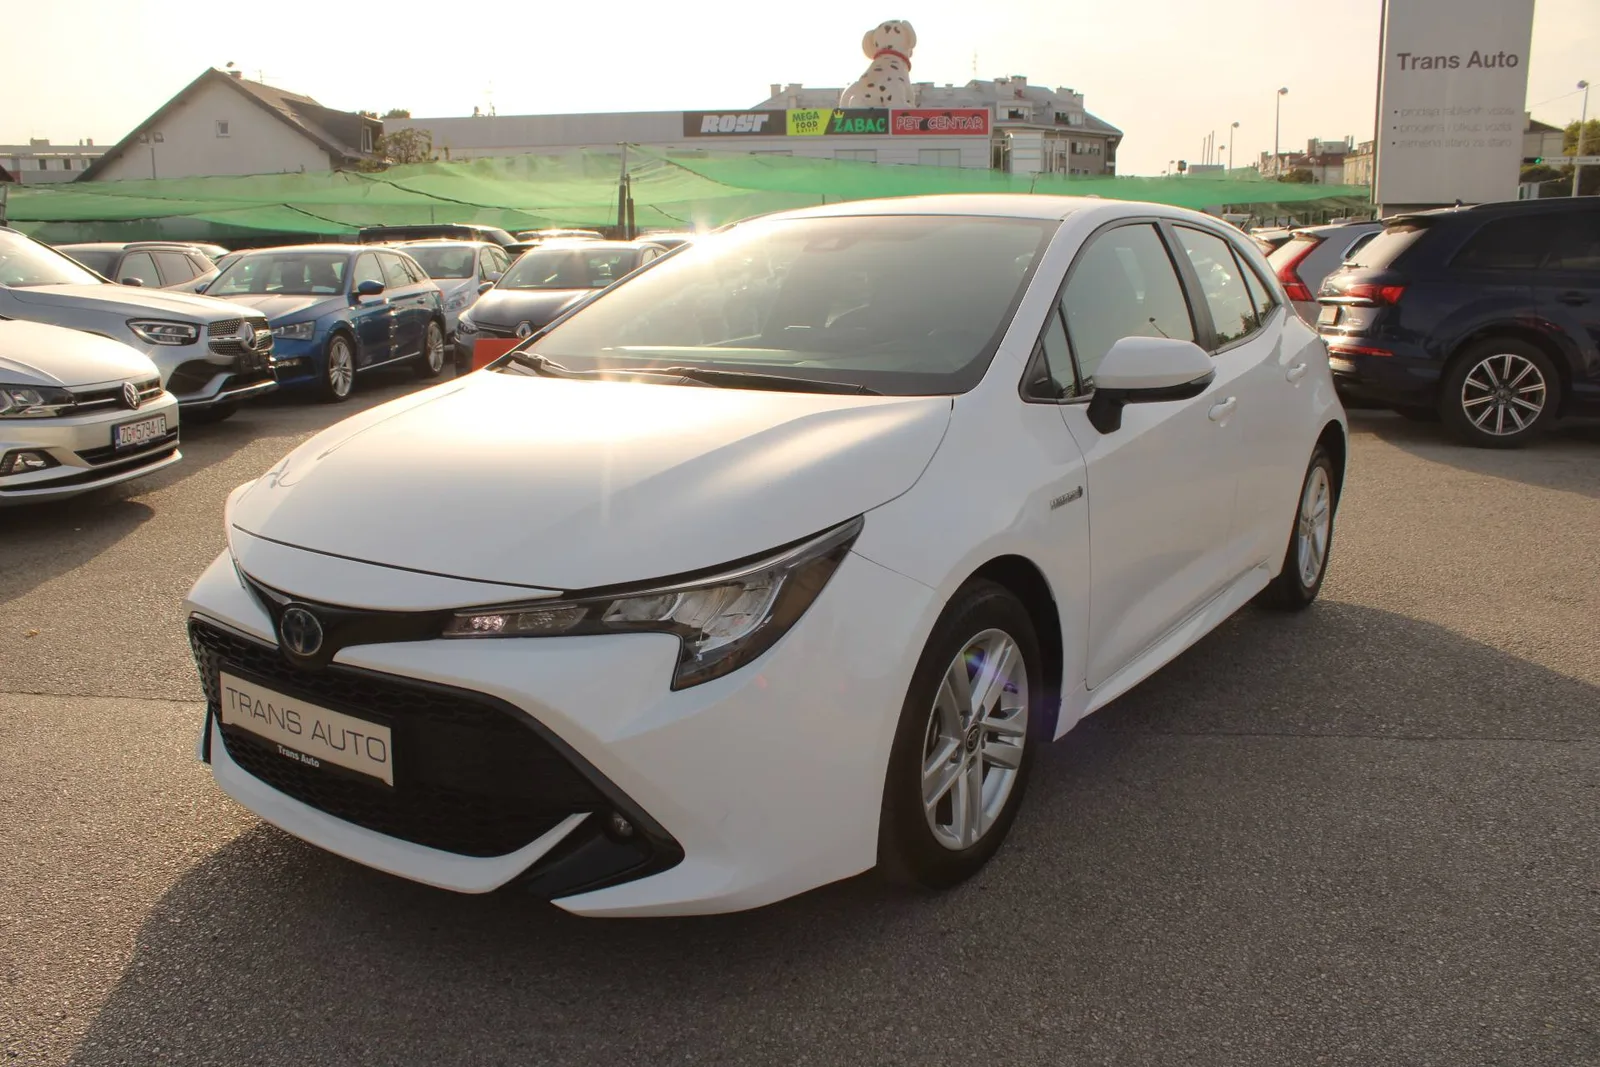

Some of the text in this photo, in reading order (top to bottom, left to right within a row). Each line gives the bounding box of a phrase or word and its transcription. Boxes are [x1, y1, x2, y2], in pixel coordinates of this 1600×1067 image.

[1397, 50, 1519, 70] Trans Auto
[700, 114, 769, 133] ROST
[791, 111, 820, 122] MEGA
[896, 114, 984, 130] PET CENTAR
[121, 426, 132, 444] ZG
[226, 686, 387, 763] TRANS AUTO
[277, 745, 320, 768] Trans Auto
